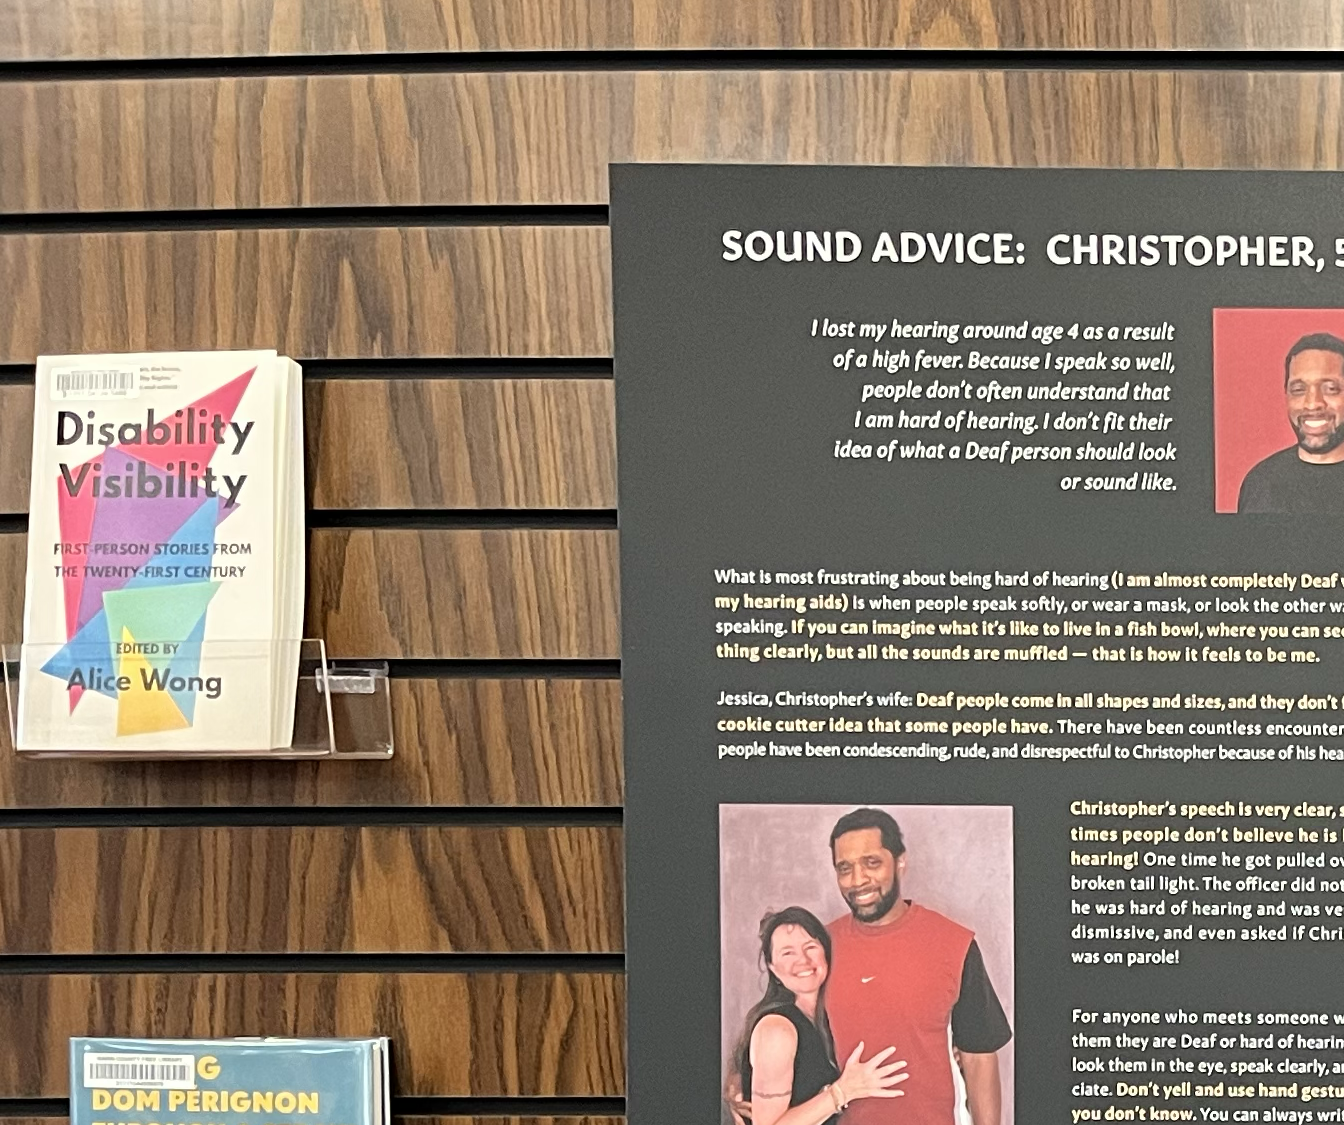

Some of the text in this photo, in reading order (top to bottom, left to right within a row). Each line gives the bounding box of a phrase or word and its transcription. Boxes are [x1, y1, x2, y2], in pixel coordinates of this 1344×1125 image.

[722, 230, 862, 262] SOUND
[872, 231, 1025, 265] ADVICE:
[1047, 234, 1324, 273] CHRISTOPHER,
[862, 380, 922, 403] people
[977, 381, 1023, 402] often
[1027, 381, 1129, 400] understand
[1134, 382, 1171, 400] that
[56, 408, 255, 455] Disability
[58, 461, 248, 509] Visibility
[54, 543, 252, 555] FIRST-PERSON STORIES FROM
[55, 566, 246, 578] THE TWENTY-FIRST CENTURY
[116, 643, 179, 655] EDITED BY
[67, 667, 222, 699] Alice Wong
[1071, 949, 1180, 968] was on parole!
[93, 1090, 318, 1114] DOM PERIGNON
